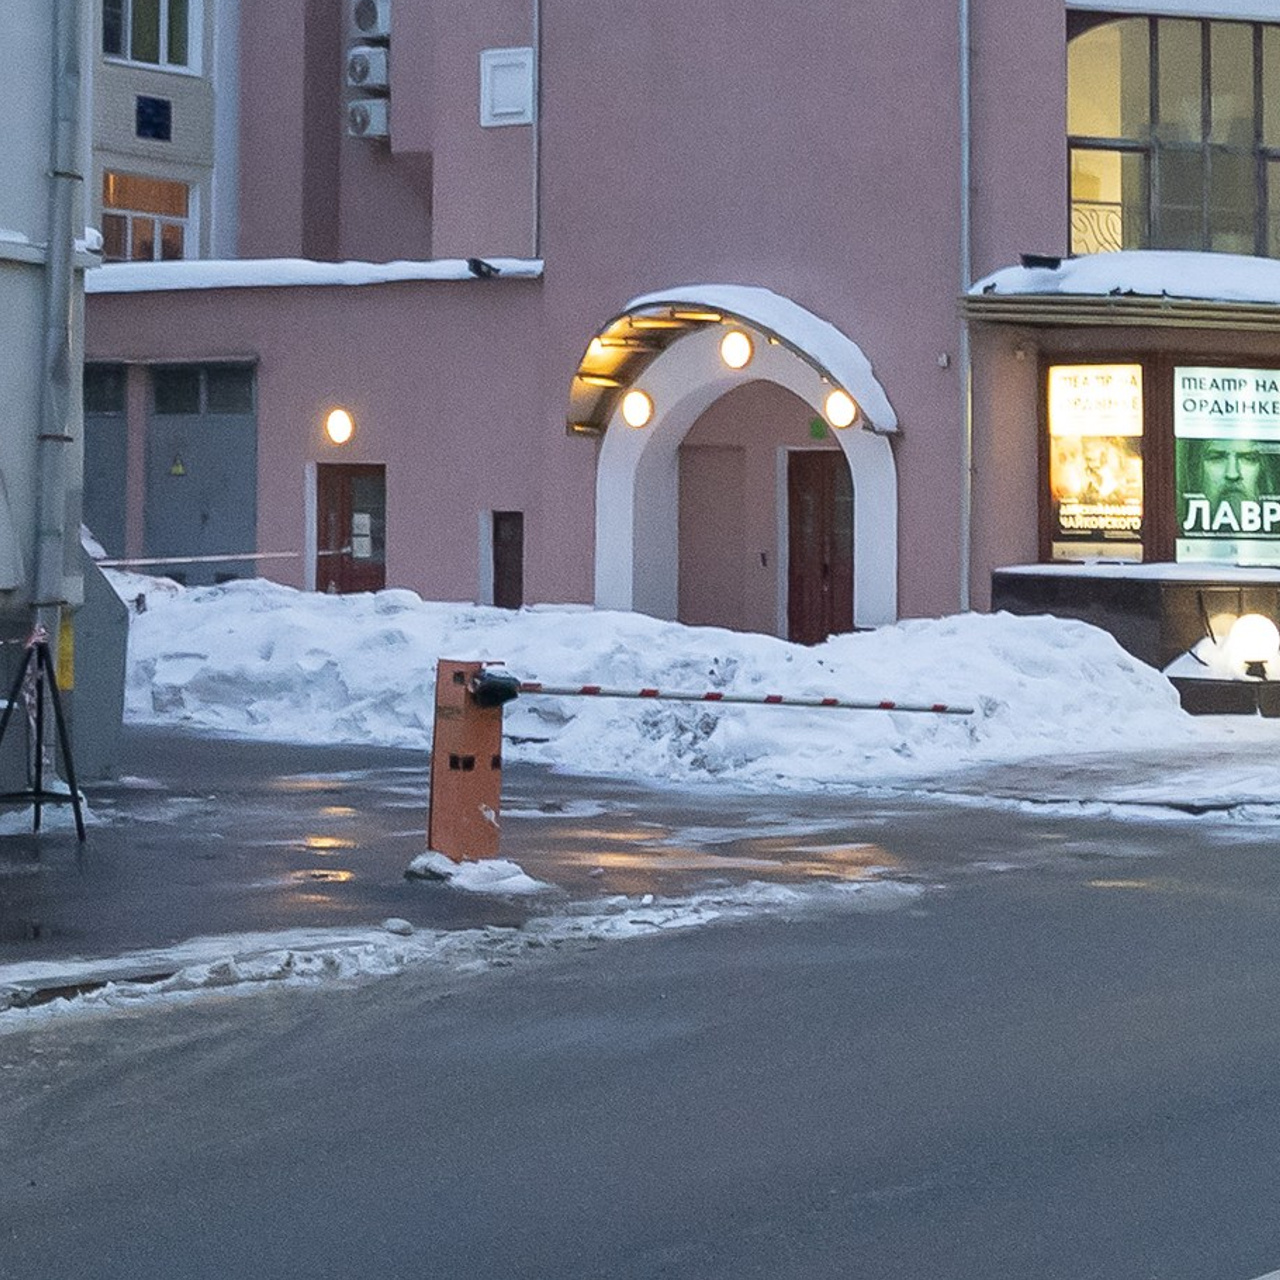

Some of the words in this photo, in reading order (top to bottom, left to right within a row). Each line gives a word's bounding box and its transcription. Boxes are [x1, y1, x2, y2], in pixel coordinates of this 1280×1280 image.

[1181, 376, 1248, 392] ТЕАТР
[1255, 379, 1280, 393] НА
[1182, 398, 1280, 416] ОРДЫНКЕ
